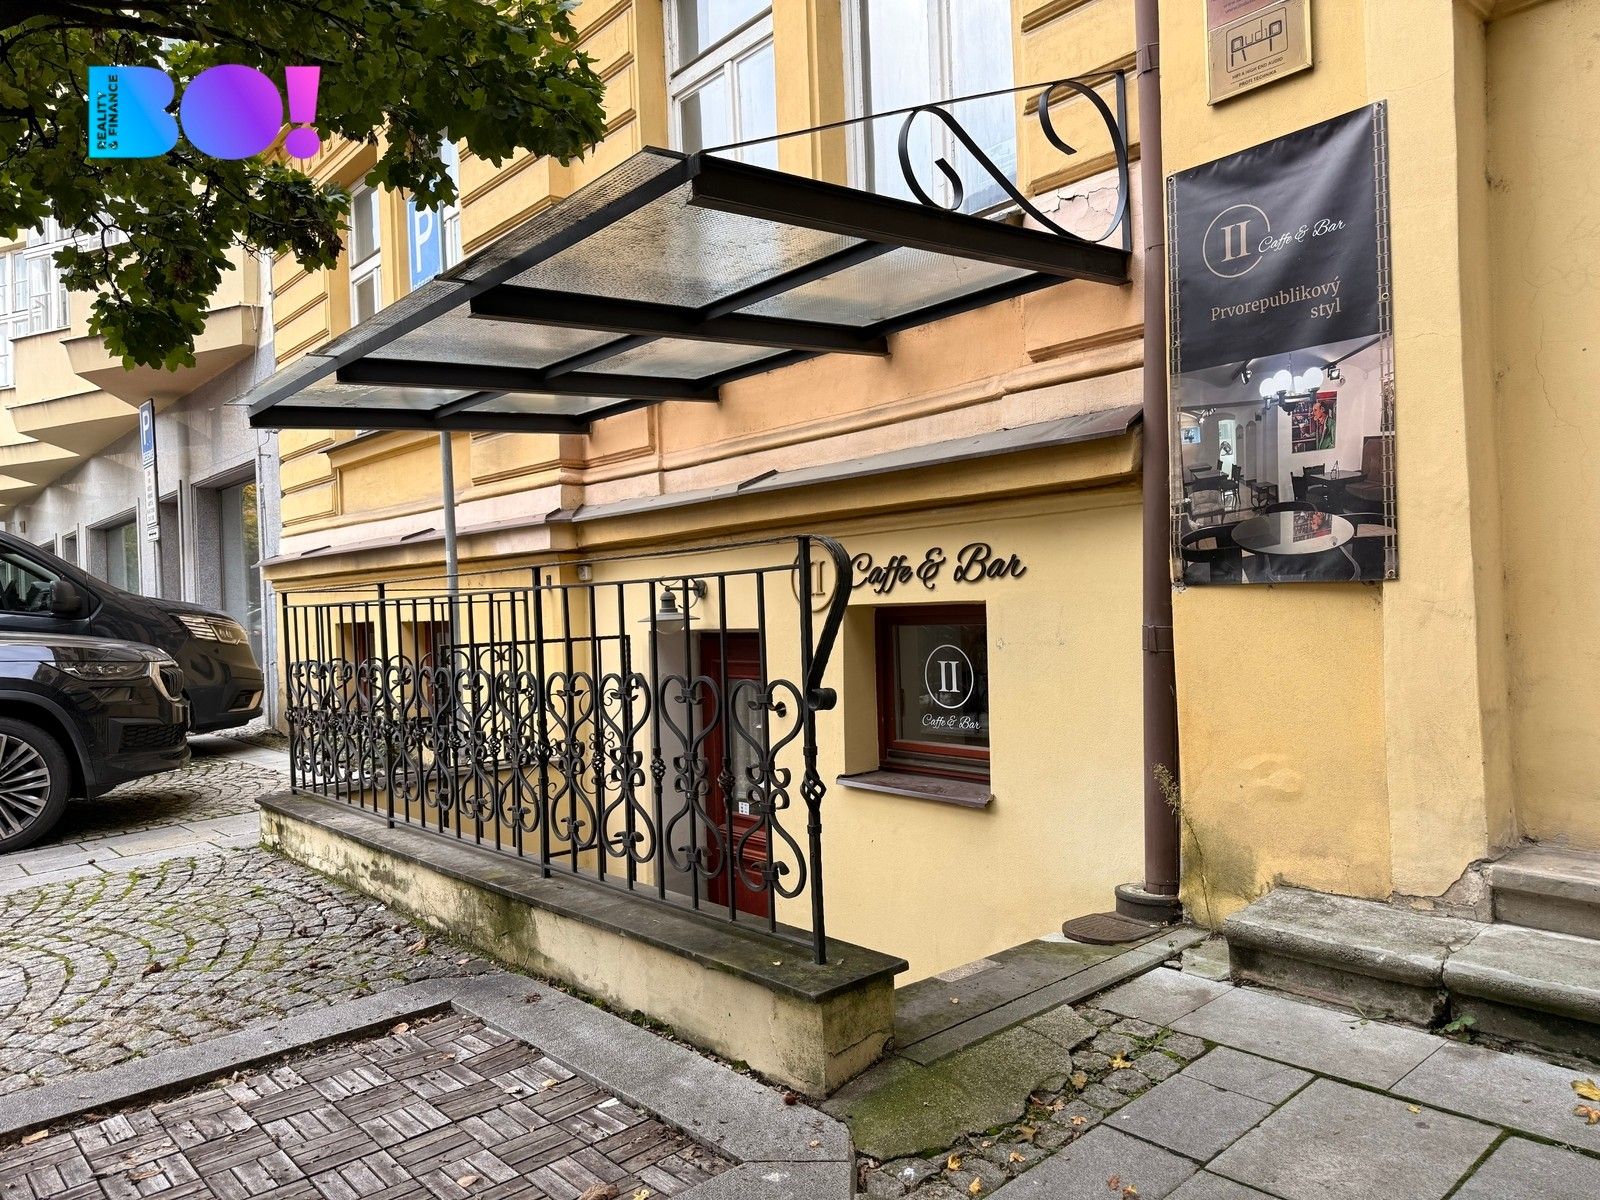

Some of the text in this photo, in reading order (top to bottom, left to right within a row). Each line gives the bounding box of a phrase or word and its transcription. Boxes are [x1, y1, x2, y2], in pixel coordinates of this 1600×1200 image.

[1238, 70, 1277, 87] PROFI TECHNIKA
[1257, 62, 1267, 70] END
[1268, 56, 1284, 66] AUDIO
[415, 206, 433, 273] P
[1220, 218, 1346, 262] II Caffe & Bar
[1211, 276, 1341, 321] Prvorepublikový
[1310, 298, 1342, 319] styl
[142, 410, 150, 445] P
[850, 552, 914, 593] Caffe
[916, 547, 947, 589] &
[954, 542, 1027, 583] Bar
[937, 661, 960, 692] II
[922, 713, 980, 729] Caffe & Bar
